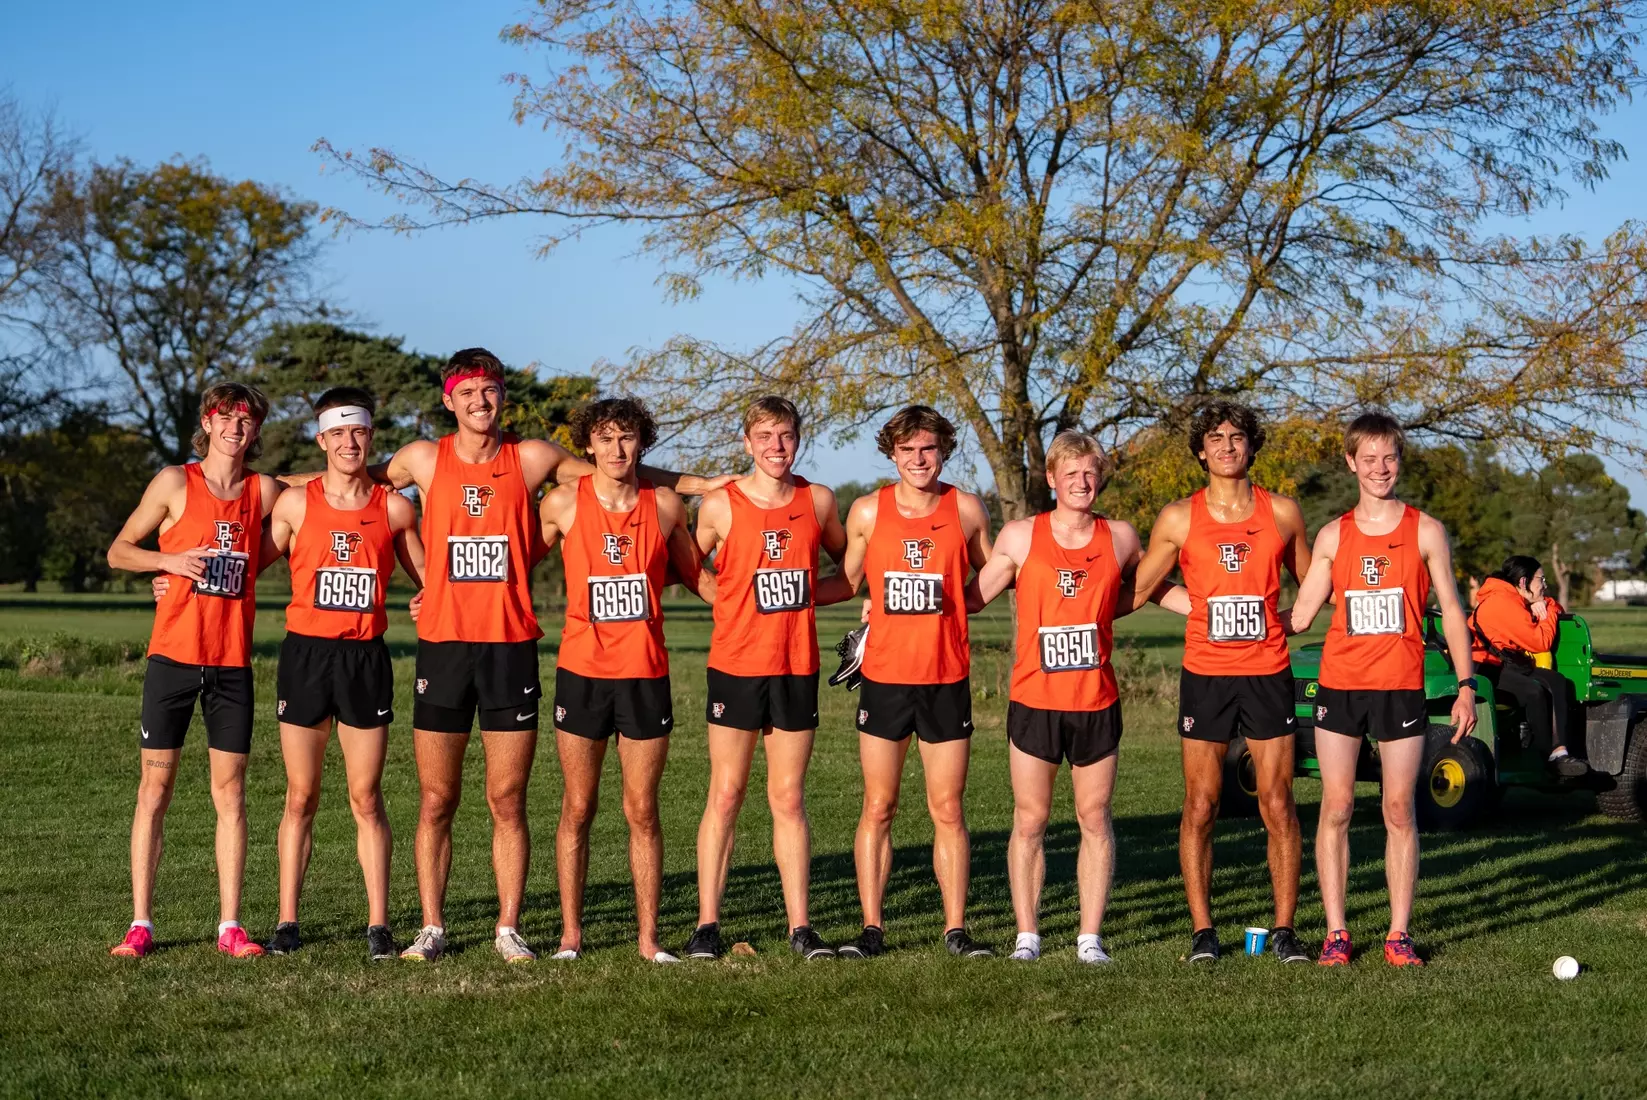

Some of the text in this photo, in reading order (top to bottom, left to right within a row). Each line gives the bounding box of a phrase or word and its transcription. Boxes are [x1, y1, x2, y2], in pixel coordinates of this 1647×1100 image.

[453, 543, 503, 577] 6962
[320, 572, 371, 607] 6959
[593, 582, 643, 617] 6956
[758, 572, 804, 607] 6957
[889, 578, 936, 611] 6961
[1212, 603, 1259, 638] 6955
[1351, 595, 1399, 631] 6960
[1044, 632, 1094, 667] 6954
[1599, 668, 1632, 677] JOHN DEERE
